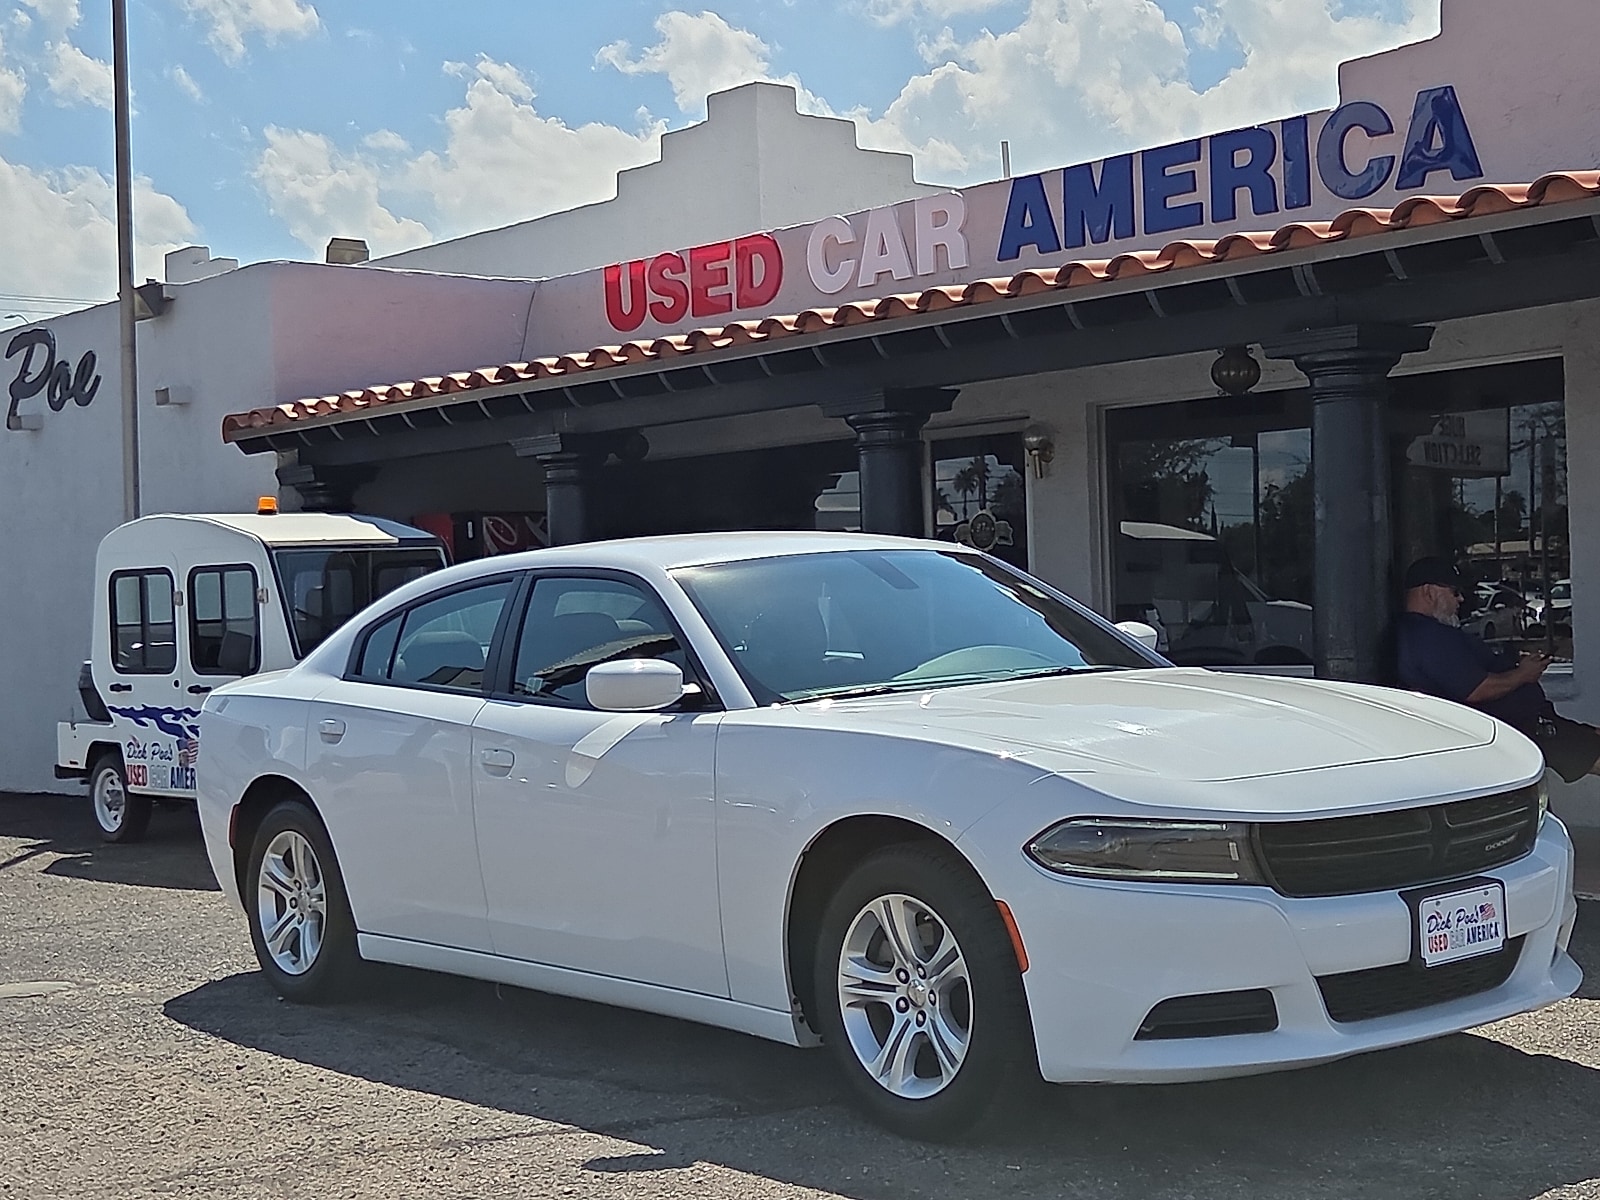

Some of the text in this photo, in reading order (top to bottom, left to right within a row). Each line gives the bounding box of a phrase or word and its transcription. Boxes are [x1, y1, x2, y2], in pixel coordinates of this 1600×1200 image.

[603, 84, 1485, 332] USED CAR AMERICA
[5, 327, 102, 430] Poe
[126, 736, 148, 760] Dick
[126, 764, 148, 787] USED
[1426, 904, 1479, 934] Dick Poe's
[1427, 932, 1449, 954] USED
[1466, 921, 1500, 946] AMERICA
